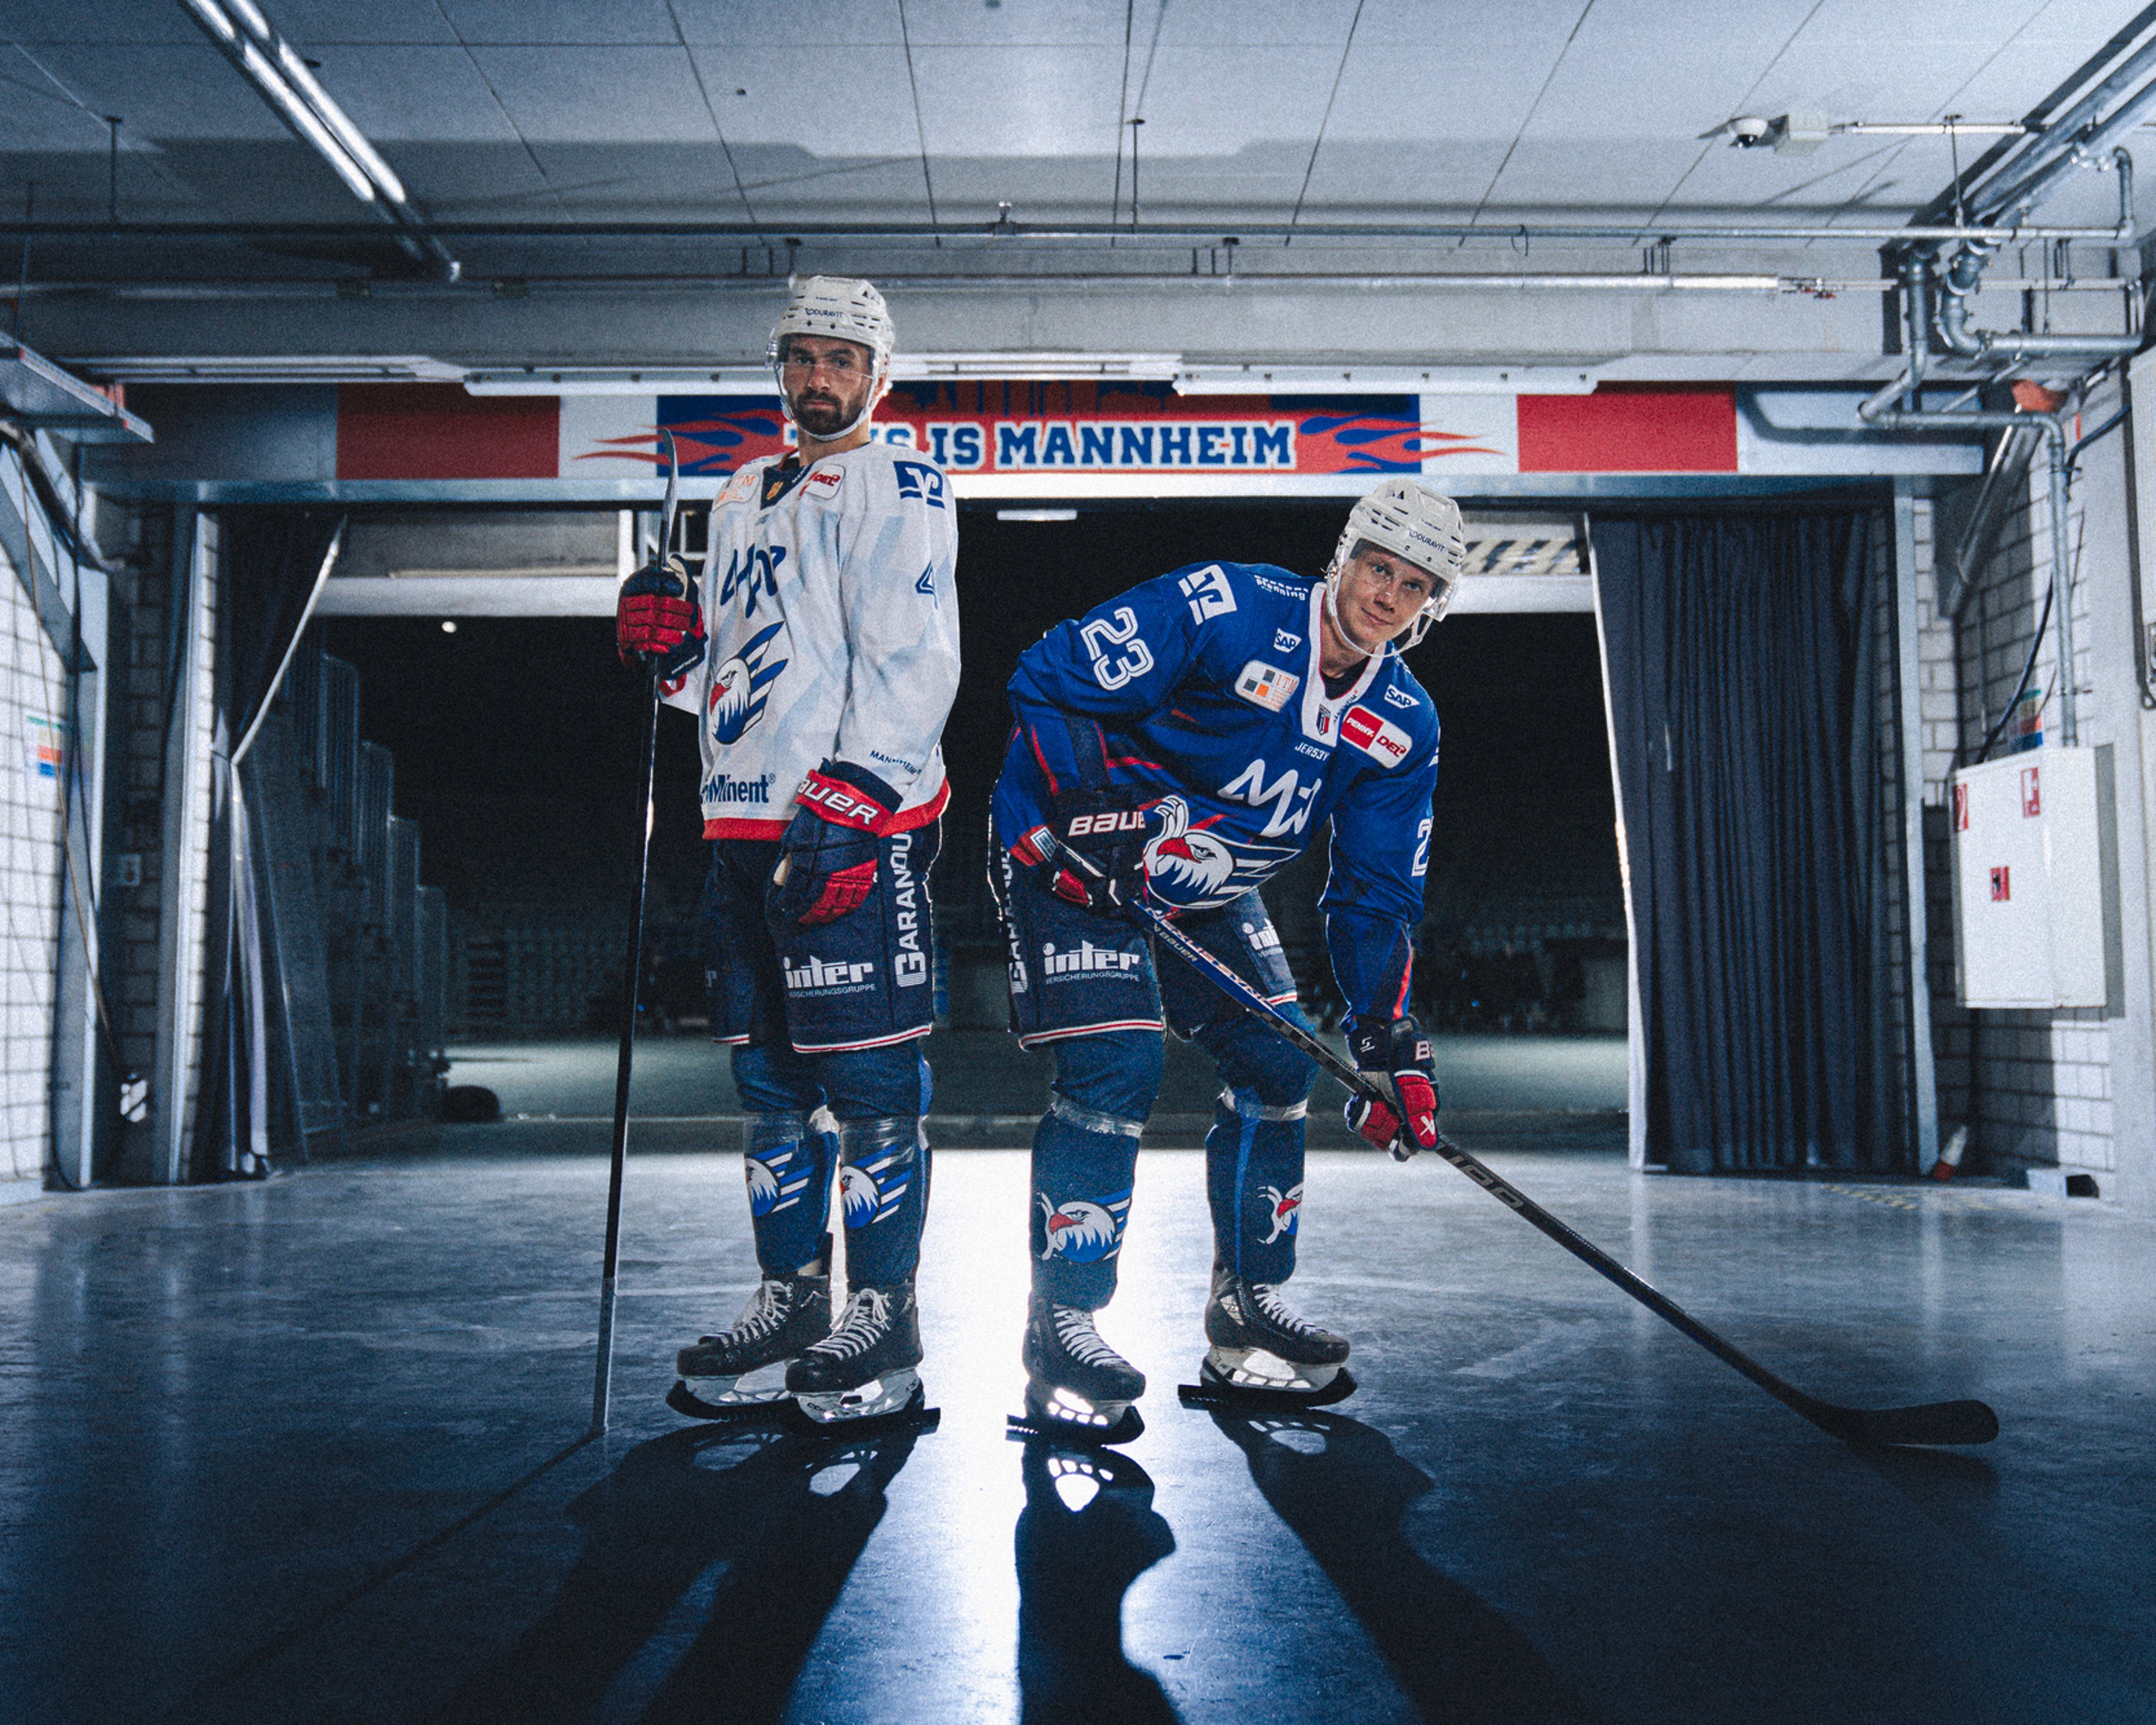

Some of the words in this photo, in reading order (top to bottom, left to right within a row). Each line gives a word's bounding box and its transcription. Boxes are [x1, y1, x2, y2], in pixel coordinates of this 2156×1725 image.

[929, 425, 982, 468] IS
[998, 423, 1294, 467] MANNHEIM
[1080, 606, 1154, 691] 23
[1386, 689, 1412, 707] SAP
[783, 955, 874, 989] inter
[1042, 939, 1141, 976] inter
